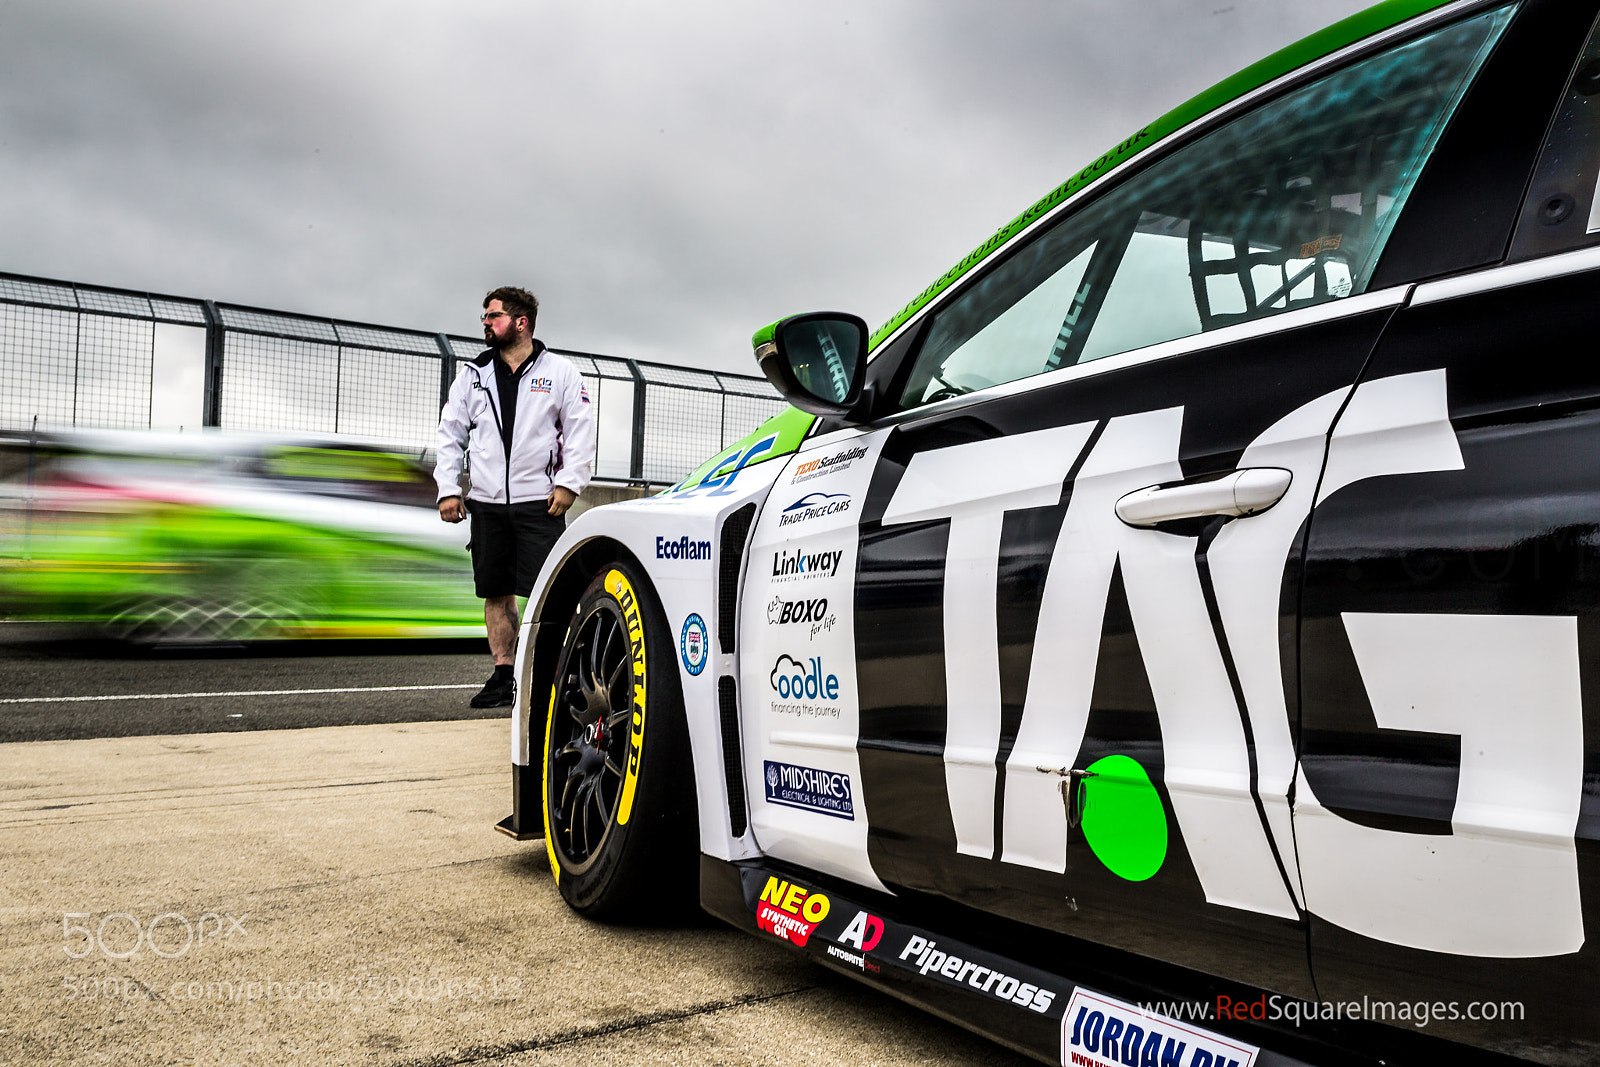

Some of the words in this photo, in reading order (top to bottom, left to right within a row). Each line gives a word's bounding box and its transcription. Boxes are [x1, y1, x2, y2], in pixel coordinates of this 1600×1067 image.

[656, 535, 711, 560] Ecoflam
[772, 549, 843, 577] Linkway
[779, 598, 828, 625] BOXO
[810, 624, 823, 641] for
[823, 614, 837, 632] life
[687, 664, 701, 673] 2017
[882, 368, 1585, 958] TAG
[771, 701, 801, 717] financing
[802, 703, 814, 713] the
[814, 704, 841, 719] journey
[780, 765, 850, 799] MIDSHIRES
[781, 789, 811, 804] ELECTRICAL
[817, 797, 842, 809] LIGHTING
[842, 801, 852, 811] LTD
[759, 875, 831, 924] NEO
[760, 907, 809, 937] SYNTHETIC
[773, 923, 789, 940] OIL
[899, 935, 1057, 1014] Pipercross
[1070, 1005, 1187, 1067] JORDAN
